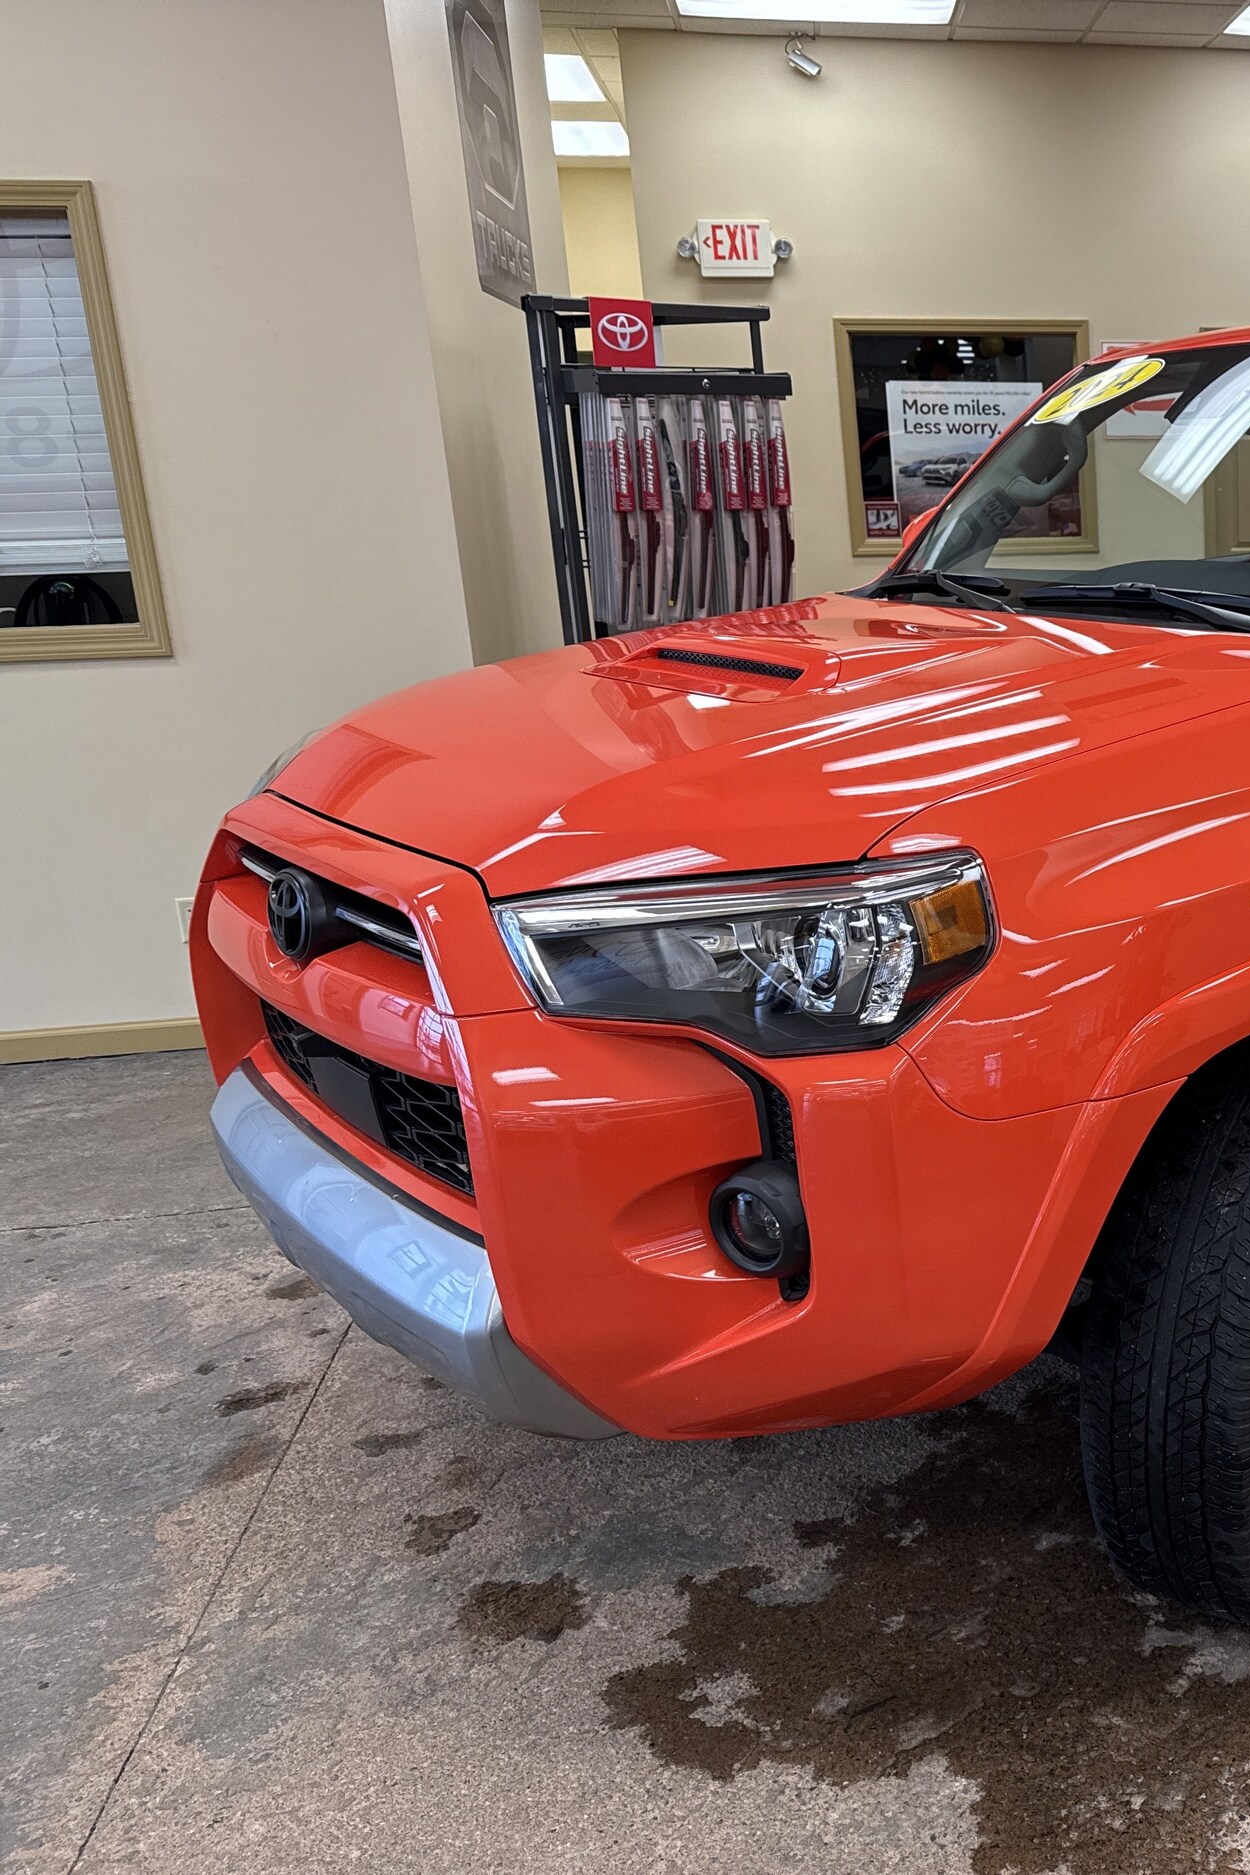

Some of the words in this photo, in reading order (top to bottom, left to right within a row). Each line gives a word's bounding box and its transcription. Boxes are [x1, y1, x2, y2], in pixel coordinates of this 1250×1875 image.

[475, 209, 532, 284] TRUCKS
[711, 224, 760, 260] EXIT
[902, 399, 949, 416] More
[954, 399, 1006, 416] miles.
[1045, 361, 1153, 419] 2024
[903, 418, 942, 435] Less
[946, 421, 1002, 439] worry.
